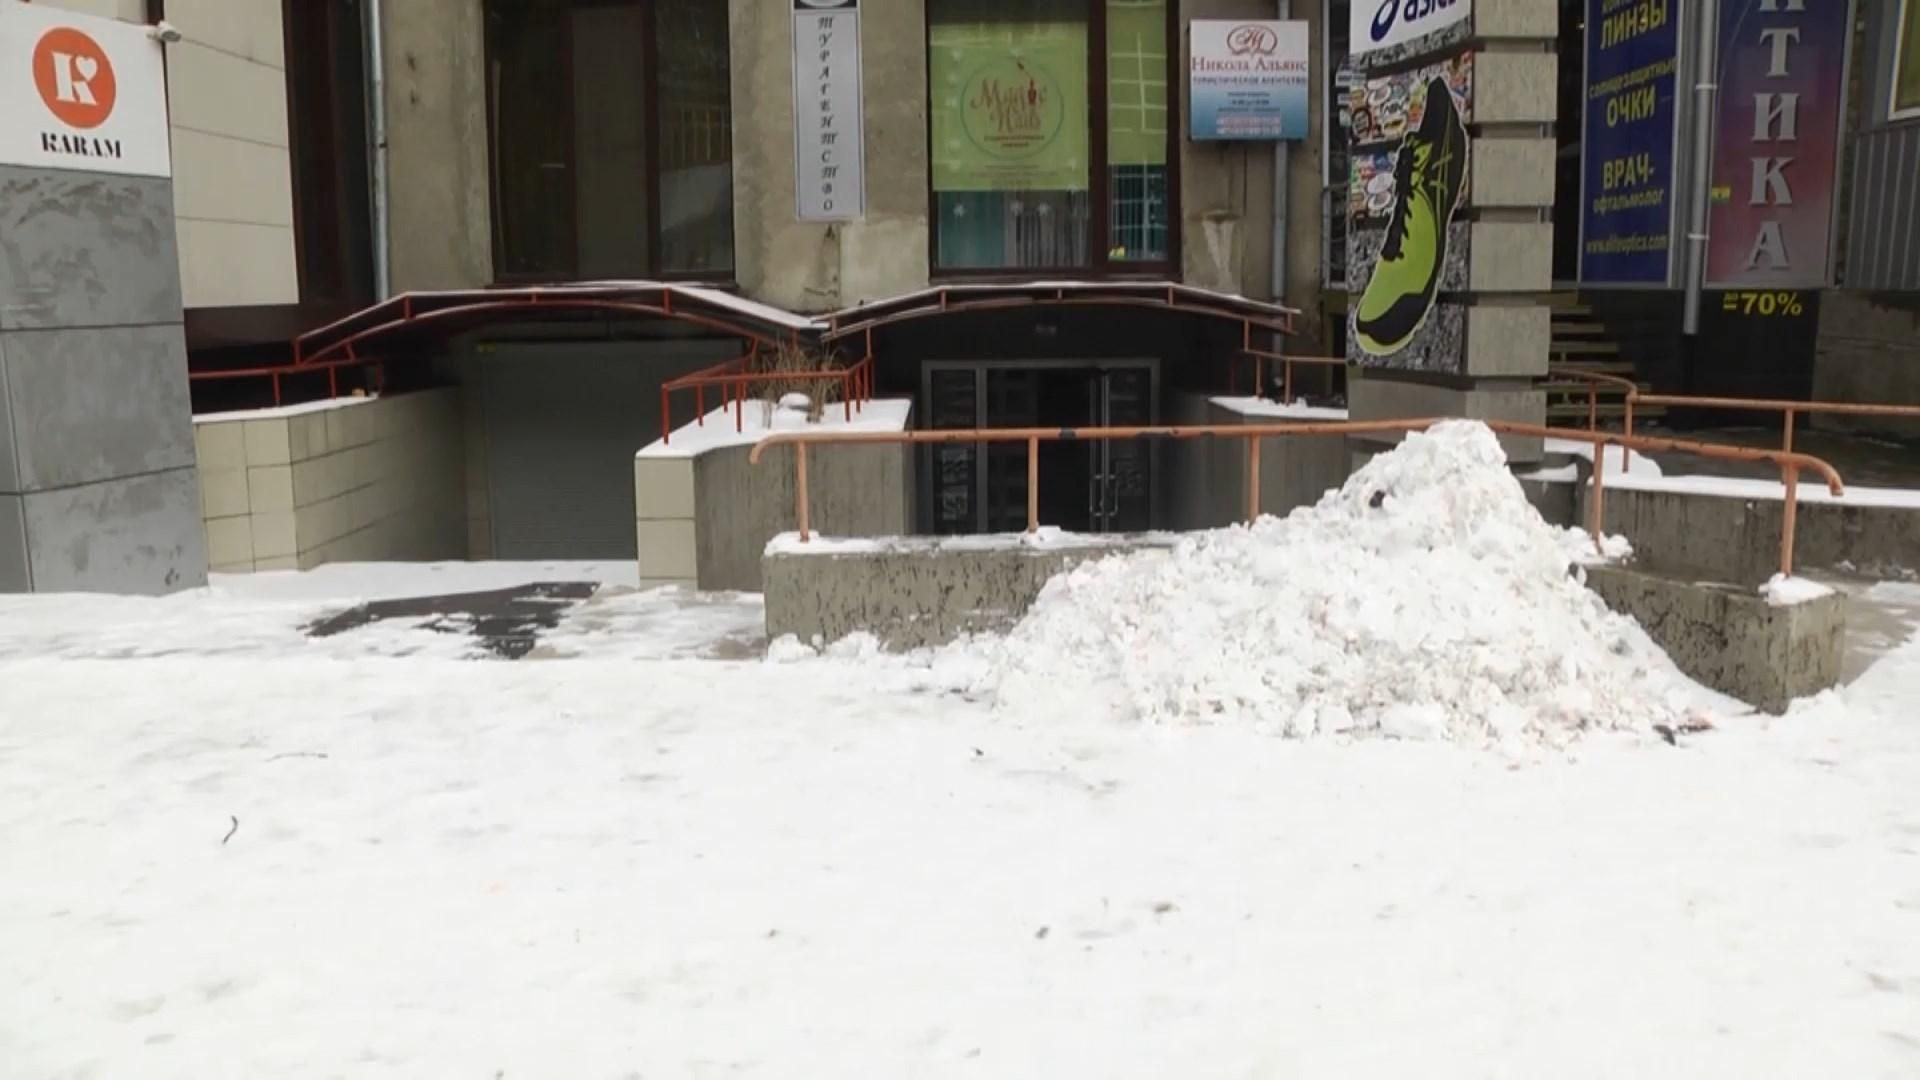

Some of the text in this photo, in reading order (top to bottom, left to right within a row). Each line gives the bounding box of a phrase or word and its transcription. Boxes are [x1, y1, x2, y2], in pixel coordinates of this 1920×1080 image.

[1404, 0, 1457, 22] asi
[1600, 0, 1666, 50] ЛИНЗЫ
[1192, 56, 1307, 72] Никола Альянс
[818, 16, 839, 211] ТУРАГЕНТСТВО
[1606, 84, 1656, 128] ОЧКИ
[41, 131, 122, 158] KARAM
[1746, 0, 1806, 270] ТИКА
[1602, 152, 1656, 190] ВРАЧ-
[1592, 188, 1665, 217] офтальмолог
